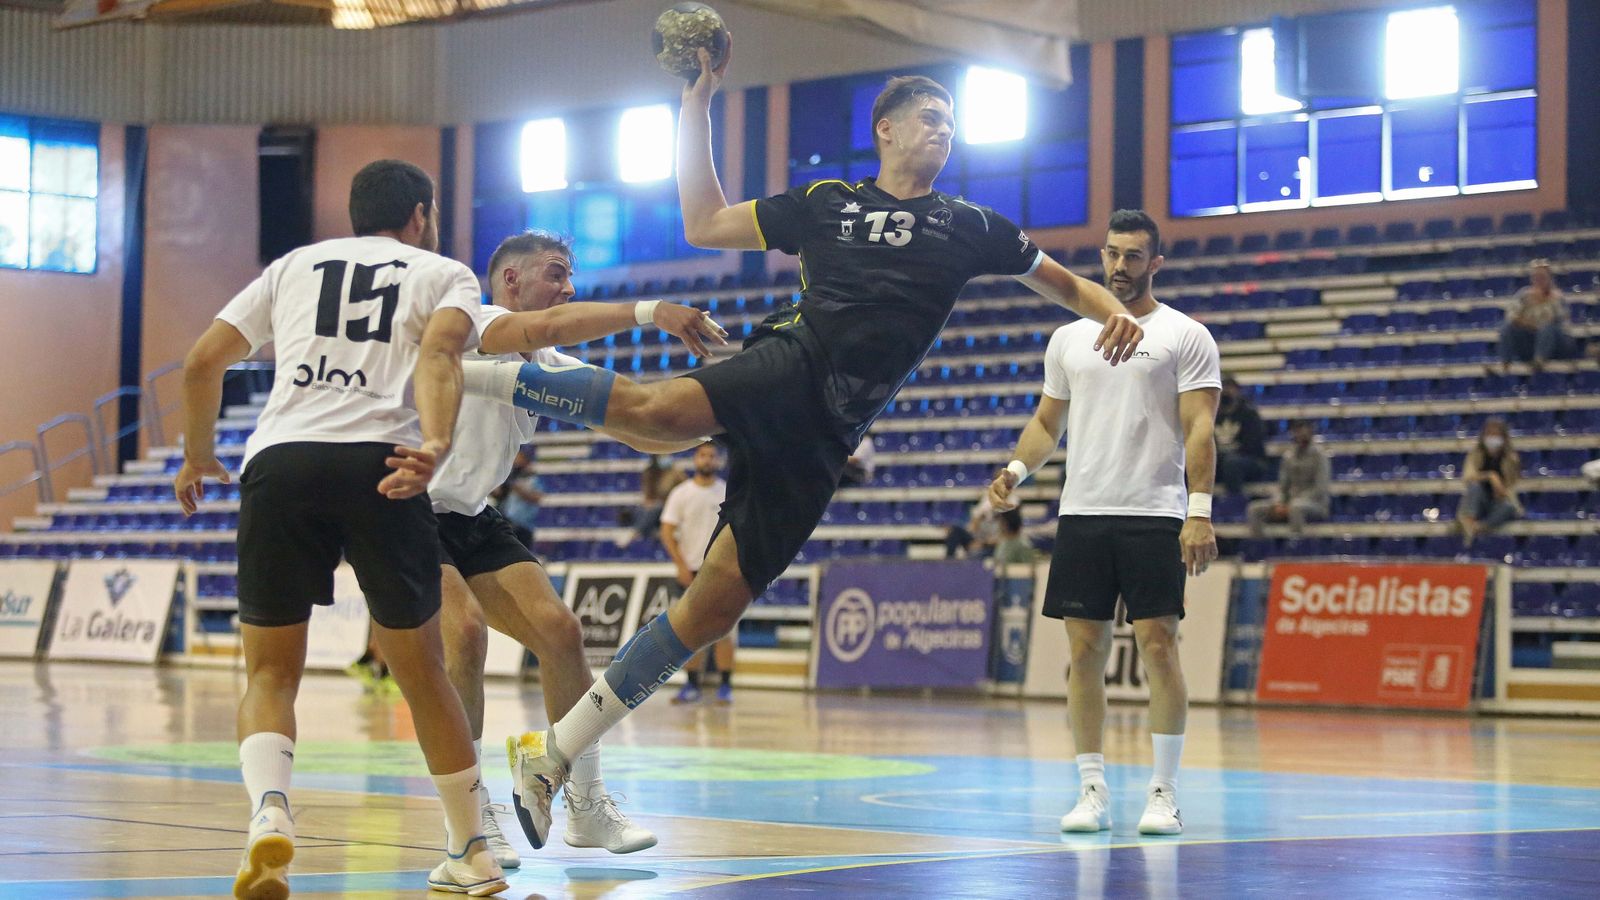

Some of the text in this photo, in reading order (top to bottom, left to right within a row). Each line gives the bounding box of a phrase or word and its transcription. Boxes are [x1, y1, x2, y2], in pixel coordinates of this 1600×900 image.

[864, 211, 916, 246] 13
[313, 259, 408, 343] 15
[575, 584, 627, 625] AC
[641, 585, 679, 624] A
[876, 593, 986, 631] populares
[1280, 575, 1472, 617] Socialistas
[60, 609, 156, 644] La Galera
[904, 628, 983, 654] Algeciras
